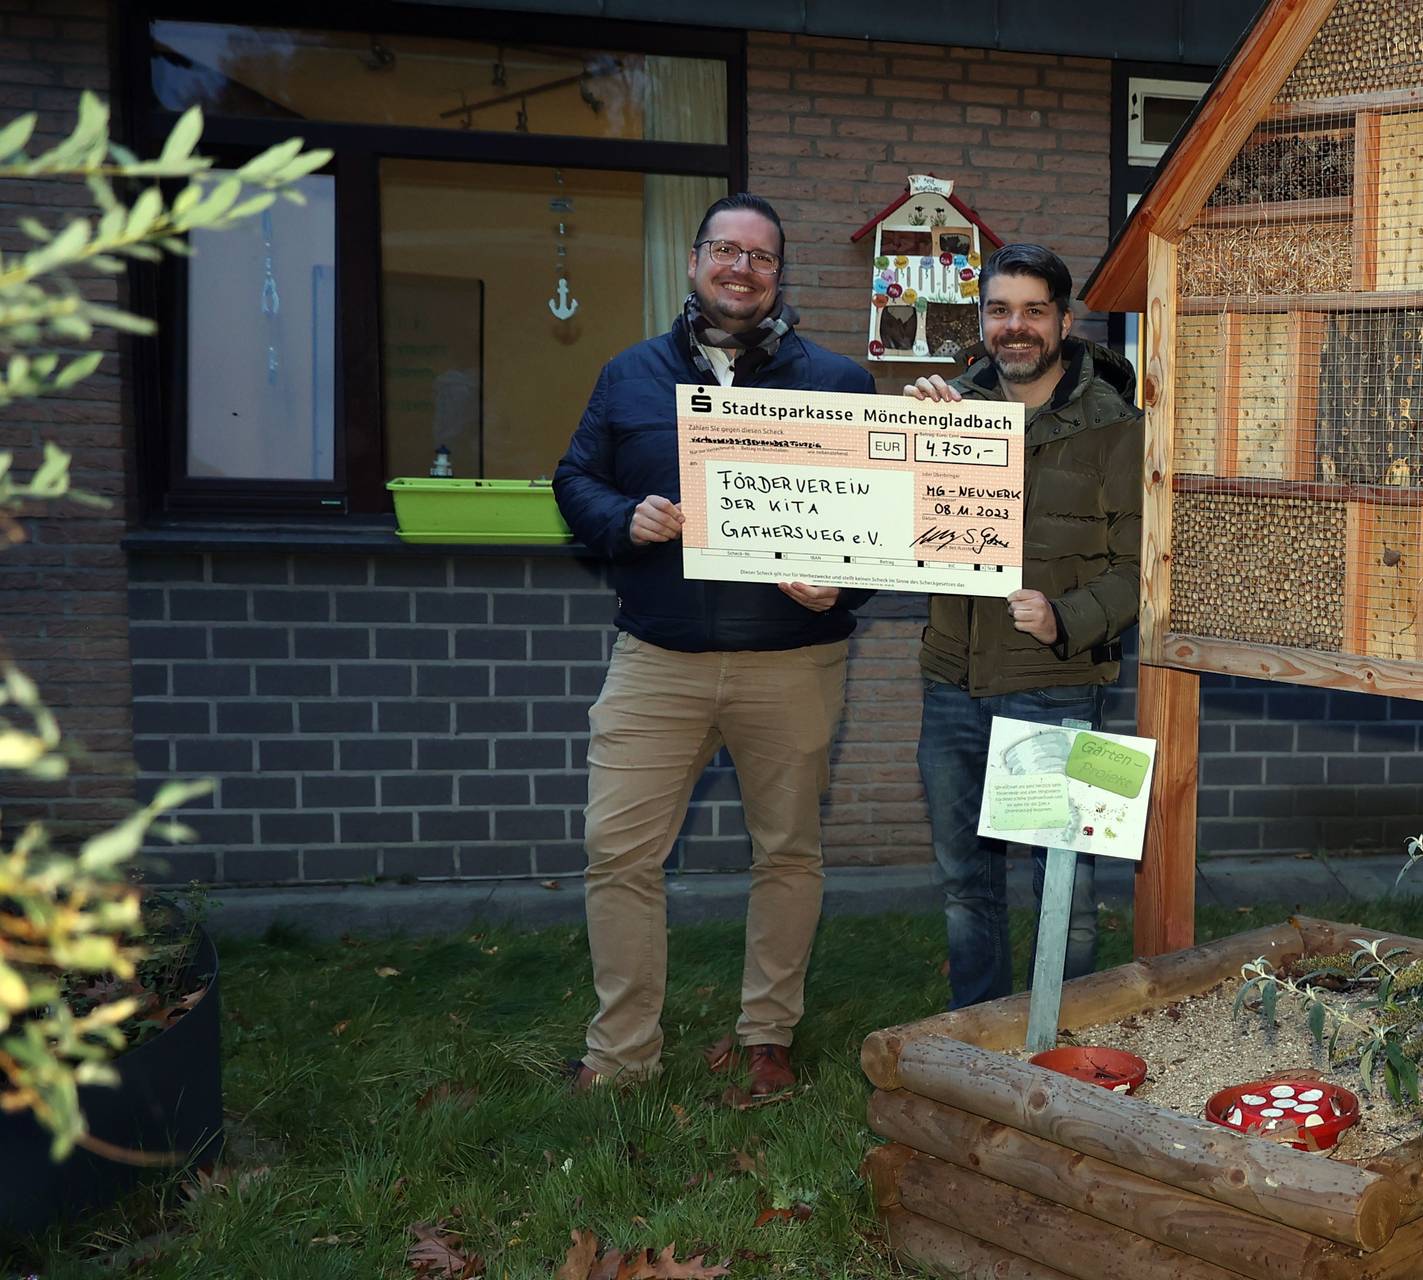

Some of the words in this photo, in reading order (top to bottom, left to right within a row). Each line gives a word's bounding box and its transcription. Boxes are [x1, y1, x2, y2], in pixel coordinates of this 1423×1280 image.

[722, 401, 853, 421] Stadtsparkasse
[864, 409, 1012, 430] Mönchengladbach
[875, 441, 900, 452] EUR
[720, 497, 755, 510] DER
[721, 520, 845, 542] GATHERSWEG
[852, 531, 883, 547] e.V.
